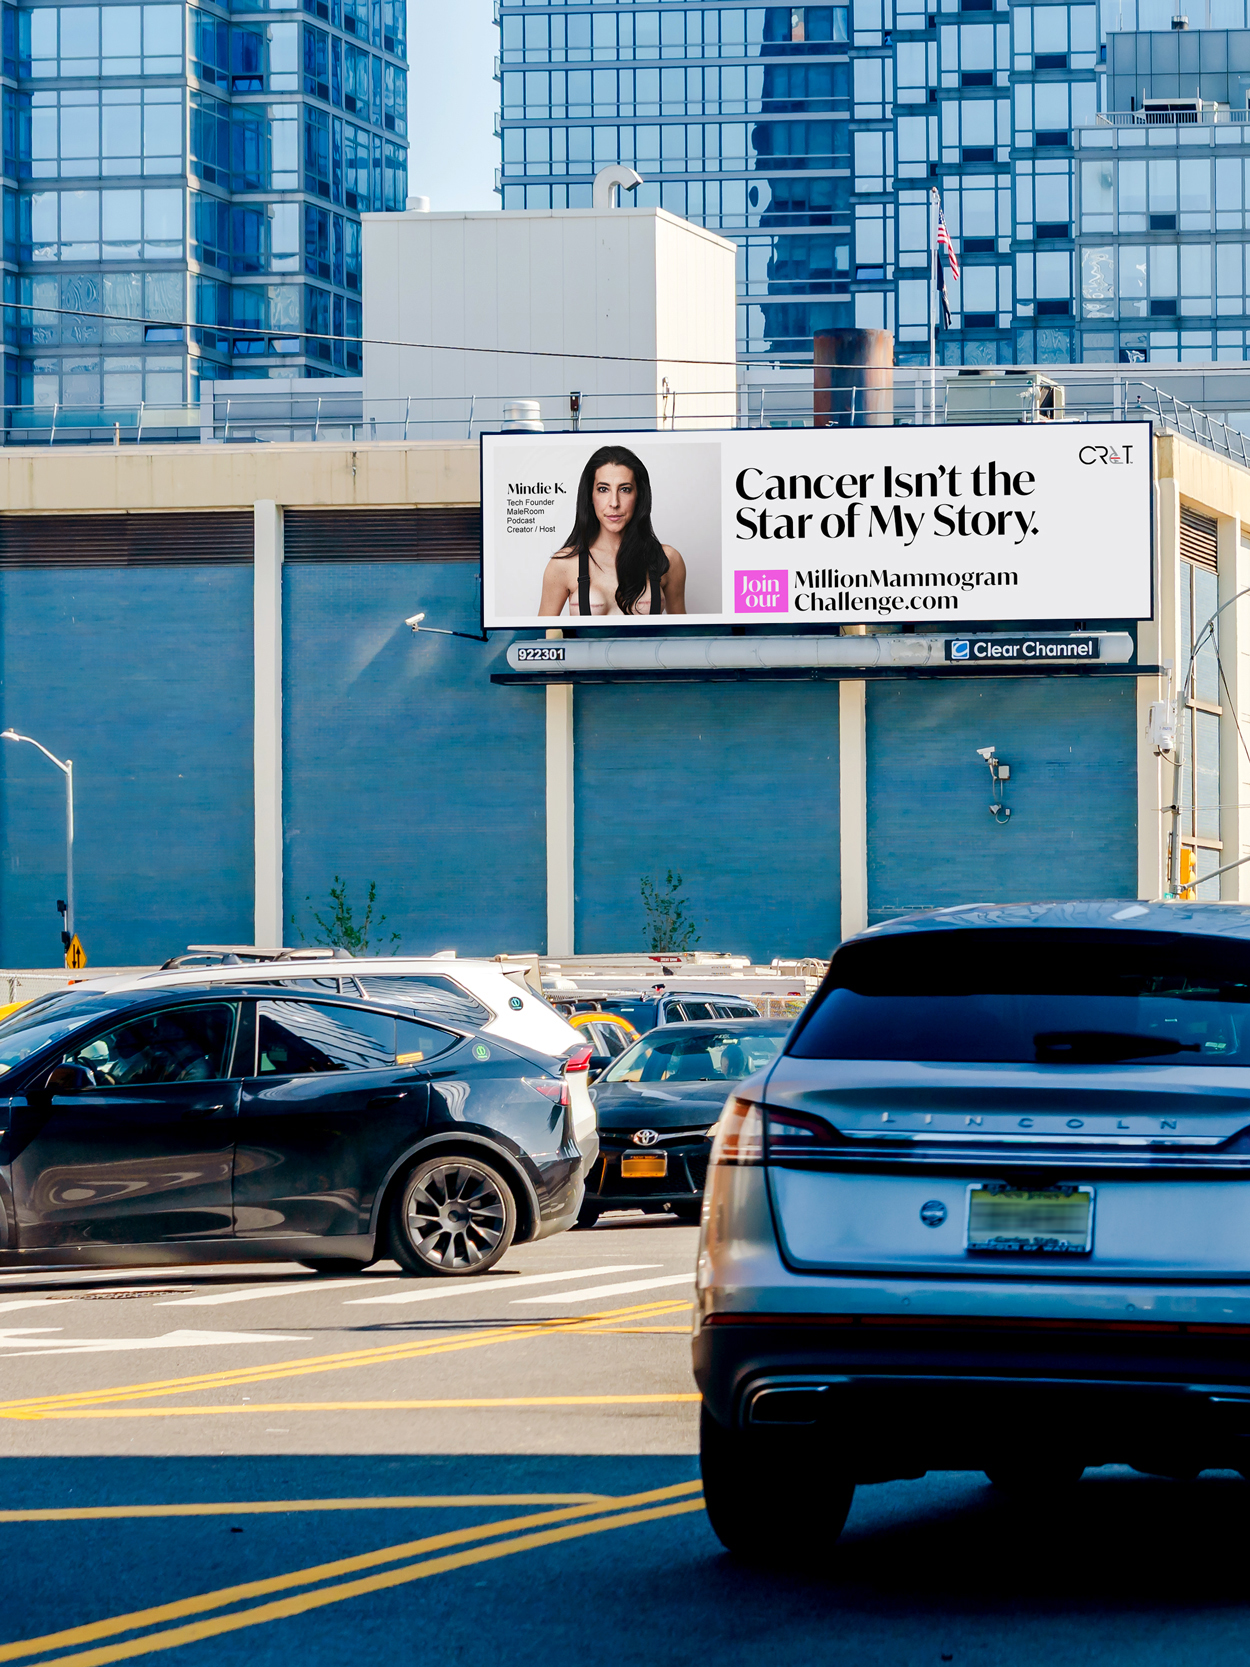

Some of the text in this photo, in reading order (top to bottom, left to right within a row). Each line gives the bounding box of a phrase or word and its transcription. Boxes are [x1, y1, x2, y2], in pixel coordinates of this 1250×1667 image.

[507, 482, 567, 495] Mindie K.
[736, 460, 1036, 501] Cancer Isn’t the
[506, 525, 533, 533] Creator
[540, 525, 556, 533] Host
[736, 502, 1039, 547] Star of My Story.
[740, 574, 780, 596] Join
[794, 568, 1018, 592] MillionMammogram
[745, 595, 780, 608] our
[794, 591, 958, 615] Challenge.com
[518, 648, 564, 660] 922301
[973, 640, 1093, 657] Clear Channel
[881, 1111, 1178, 1131] LINCOLN
